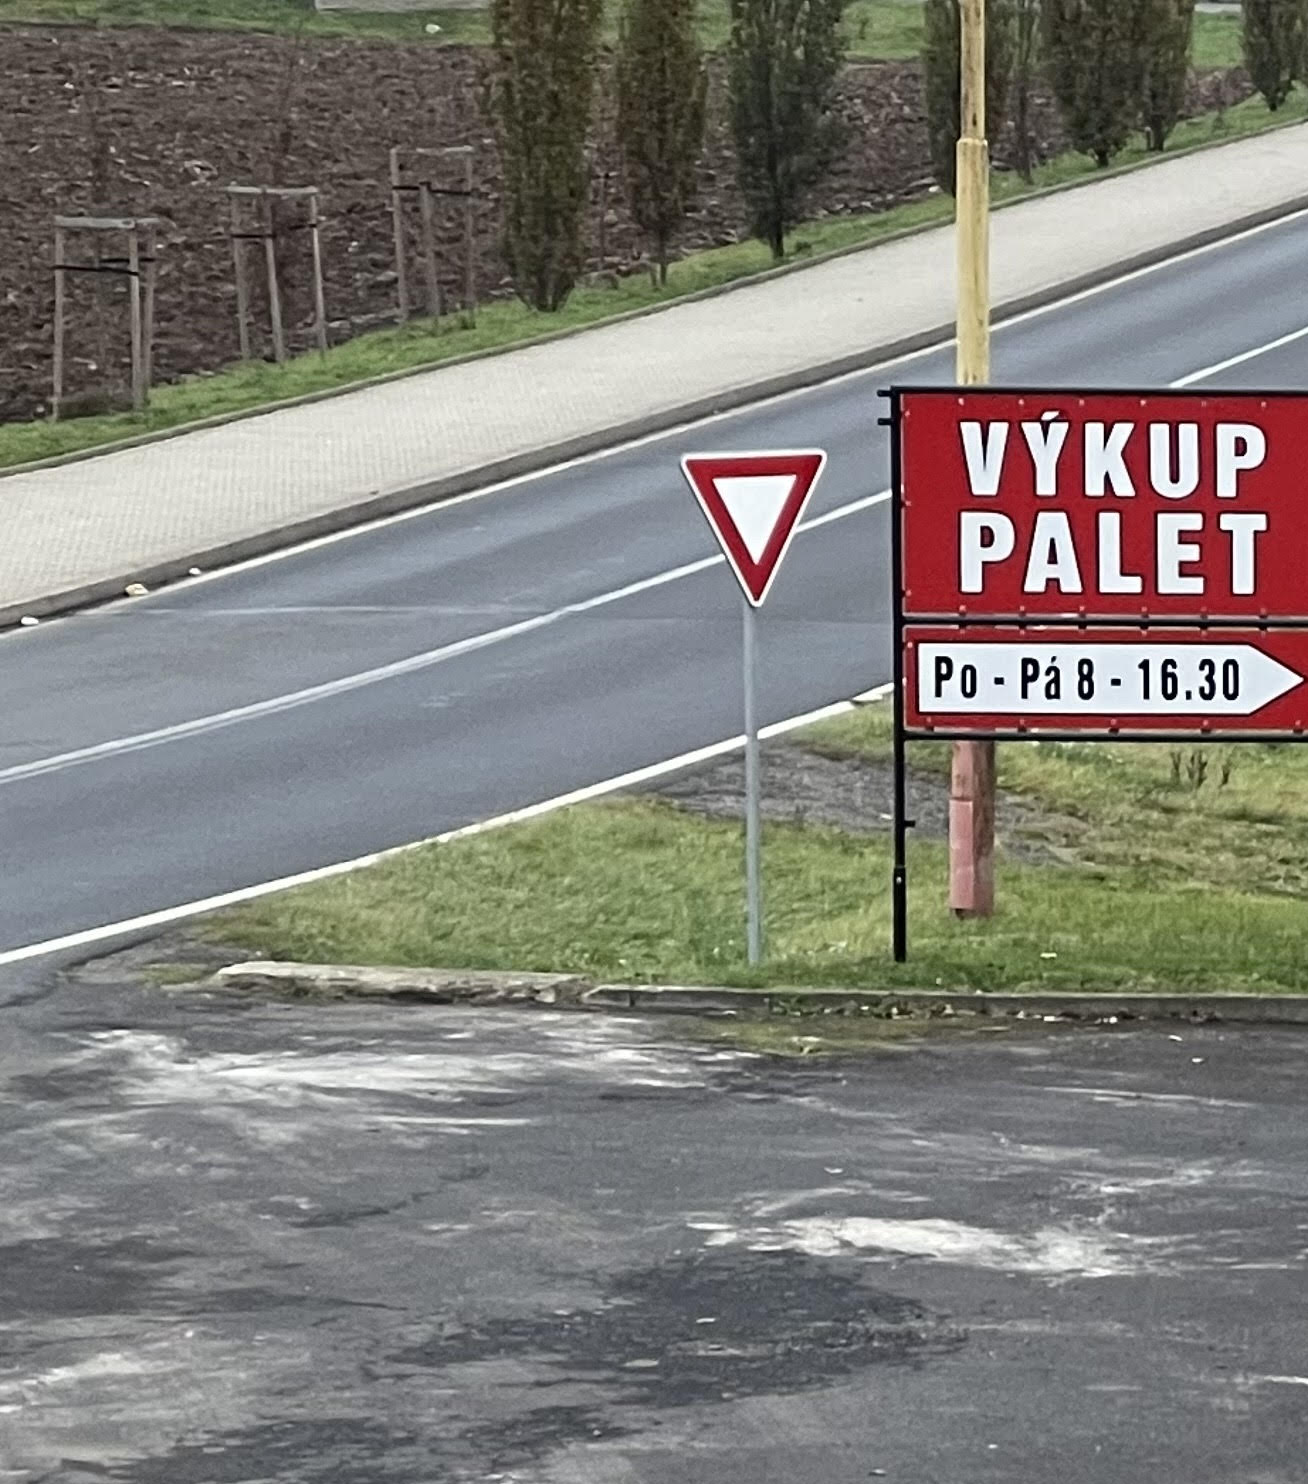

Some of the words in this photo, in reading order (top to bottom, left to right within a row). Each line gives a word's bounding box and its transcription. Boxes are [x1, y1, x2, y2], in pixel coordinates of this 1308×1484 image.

[959, 410, 1268, 499] VÝKUP
[959, 511, 1269, 595] PALET
[934, 656, 978, 699] Po
[1020, 655, 1062, 700] Pá
[1077, 658, 1096, 701] 8
[1137, 658, 1241, 701] 16.30
